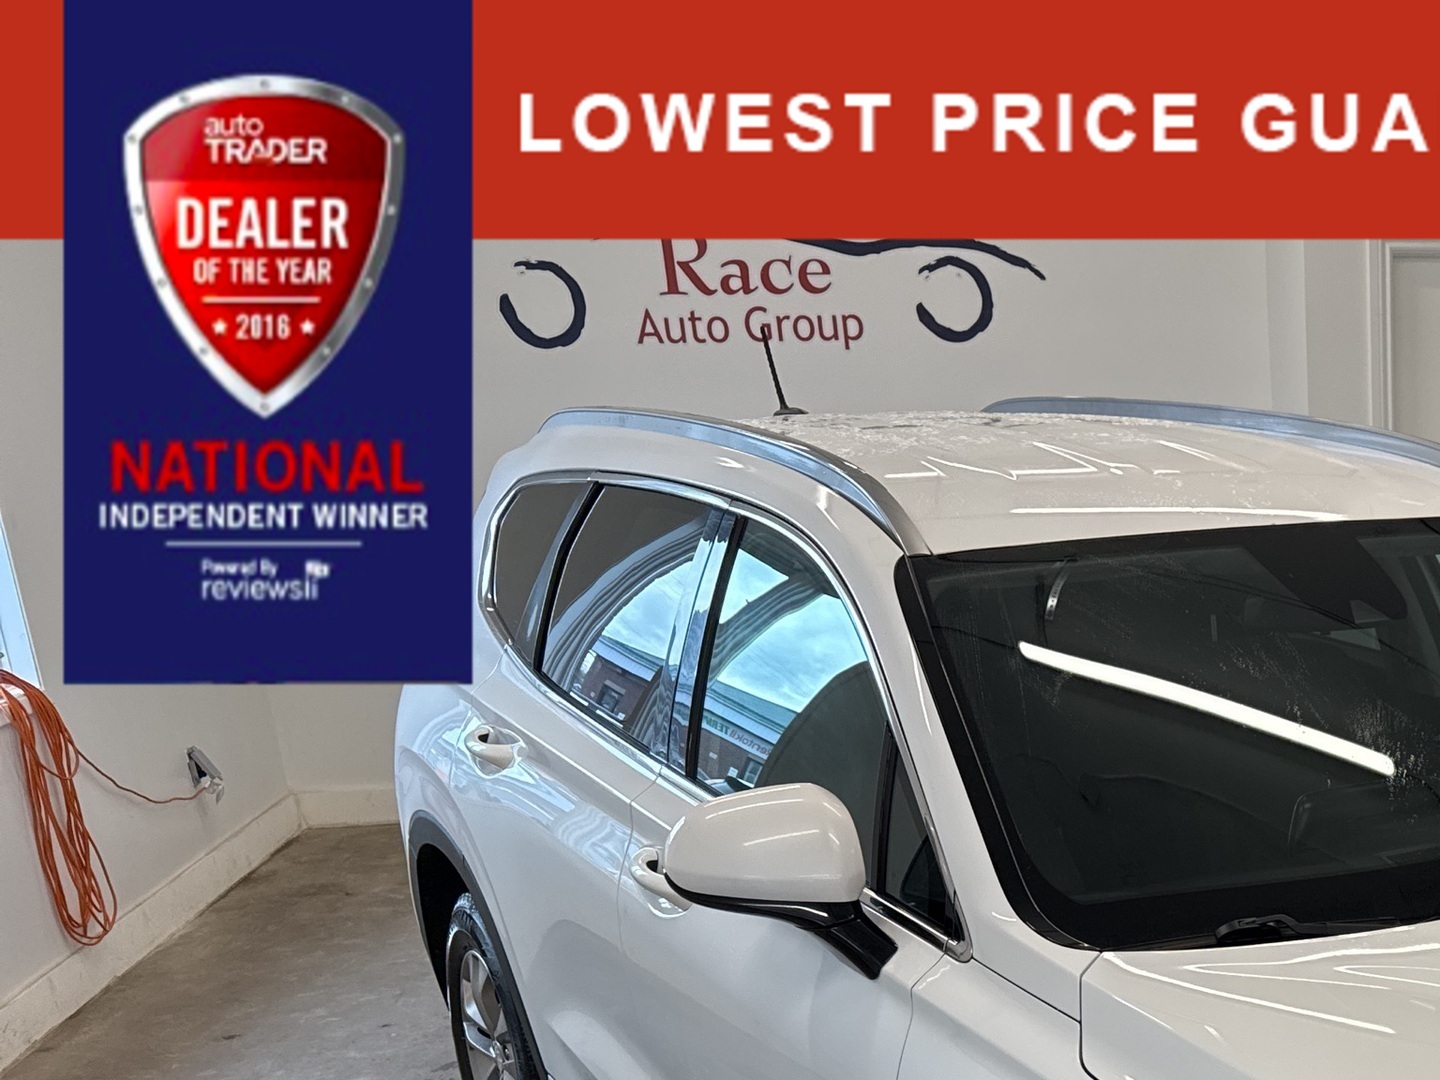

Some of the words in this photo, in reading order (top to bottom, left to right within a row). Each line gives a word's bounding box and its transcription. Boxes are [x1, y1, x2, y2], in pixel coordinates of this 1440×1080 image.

[659, 239, 832, 297] Race
[637, 309, 729, 344] Auto
[744, 306, 864, 350] Group
